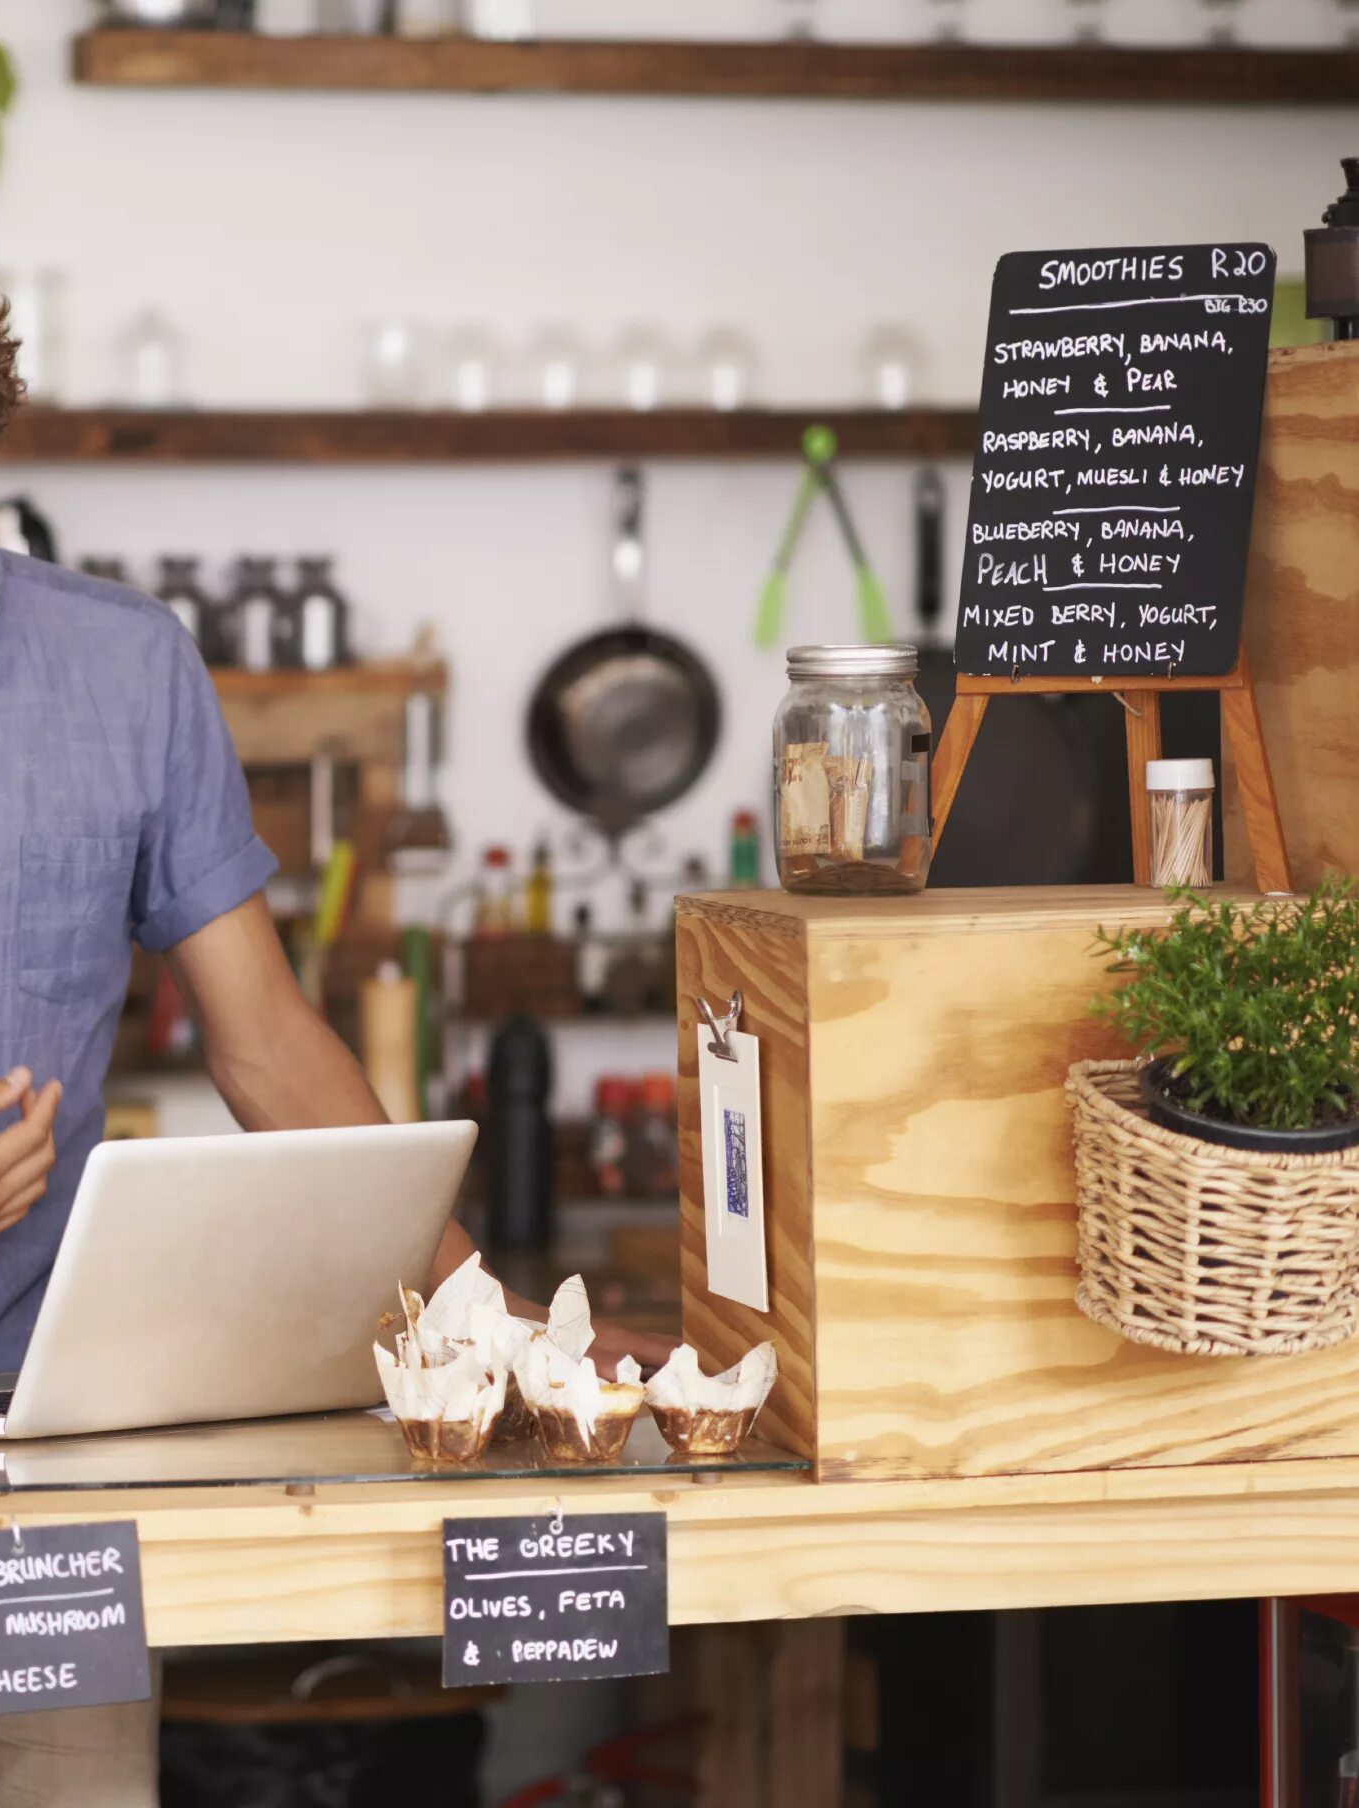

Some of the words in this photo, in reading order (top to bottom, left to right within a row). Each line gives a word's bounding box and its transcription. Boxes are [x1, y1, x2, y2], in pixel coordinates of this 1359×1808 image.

[1039, 255, 1184, 289] SMOOTHIES
[1211, 248, 1266, 279] R20
[1204, 299, 1231, 314] BIG
[994, 333, 1131, 366] STRAWBERRY,
[1140, 331, 1233, 355] BANANA,
[1003, 375, 1071, 399] HONEY
[1093, 373, 1110, 398] &
[1127, 367, 1178, 393] PEAR
[983, 428, 1102, 454] RASPBERRY,
[1112, 422, 1204, 448] BANANA,
[981, 468, 1072, 495] YOGURT,
[1077, 468, 1147, 487] MUESLI
[1159, 464, 1172, 487] &
[1178, 464, 1245, 488] HONEY
[972, 520, 1093, 549] BLUEBERRY,
[1101, 519, 1195, 542] BANANA,
[977, 552, 1048, 586] PEACH
[1072, 553, 1085, 578] &
[1099, 553, 1181, 574] HONEY
[963, 604, 1035, 628] MIXED
[1051, 602, 1127, 629] BERRY,
[1139, 603, 1218, 630] YOGURT,
[988, 639, 1056, 664] MINT
[1074, 639, 1087, 664] &
[1103, 640, 1185, 664] HONEY
[446, 1537, 499, 1562] THE
[519, 1530, 634, 1558] GREEKY
[5, 1602, 126, 1637] MUSHROOM
[449, 1595, 546, 1620] OLIVES,
[558, 1590, 626, 1613] FETA
[511, 1638, 618, 1663] PEPPADEW
